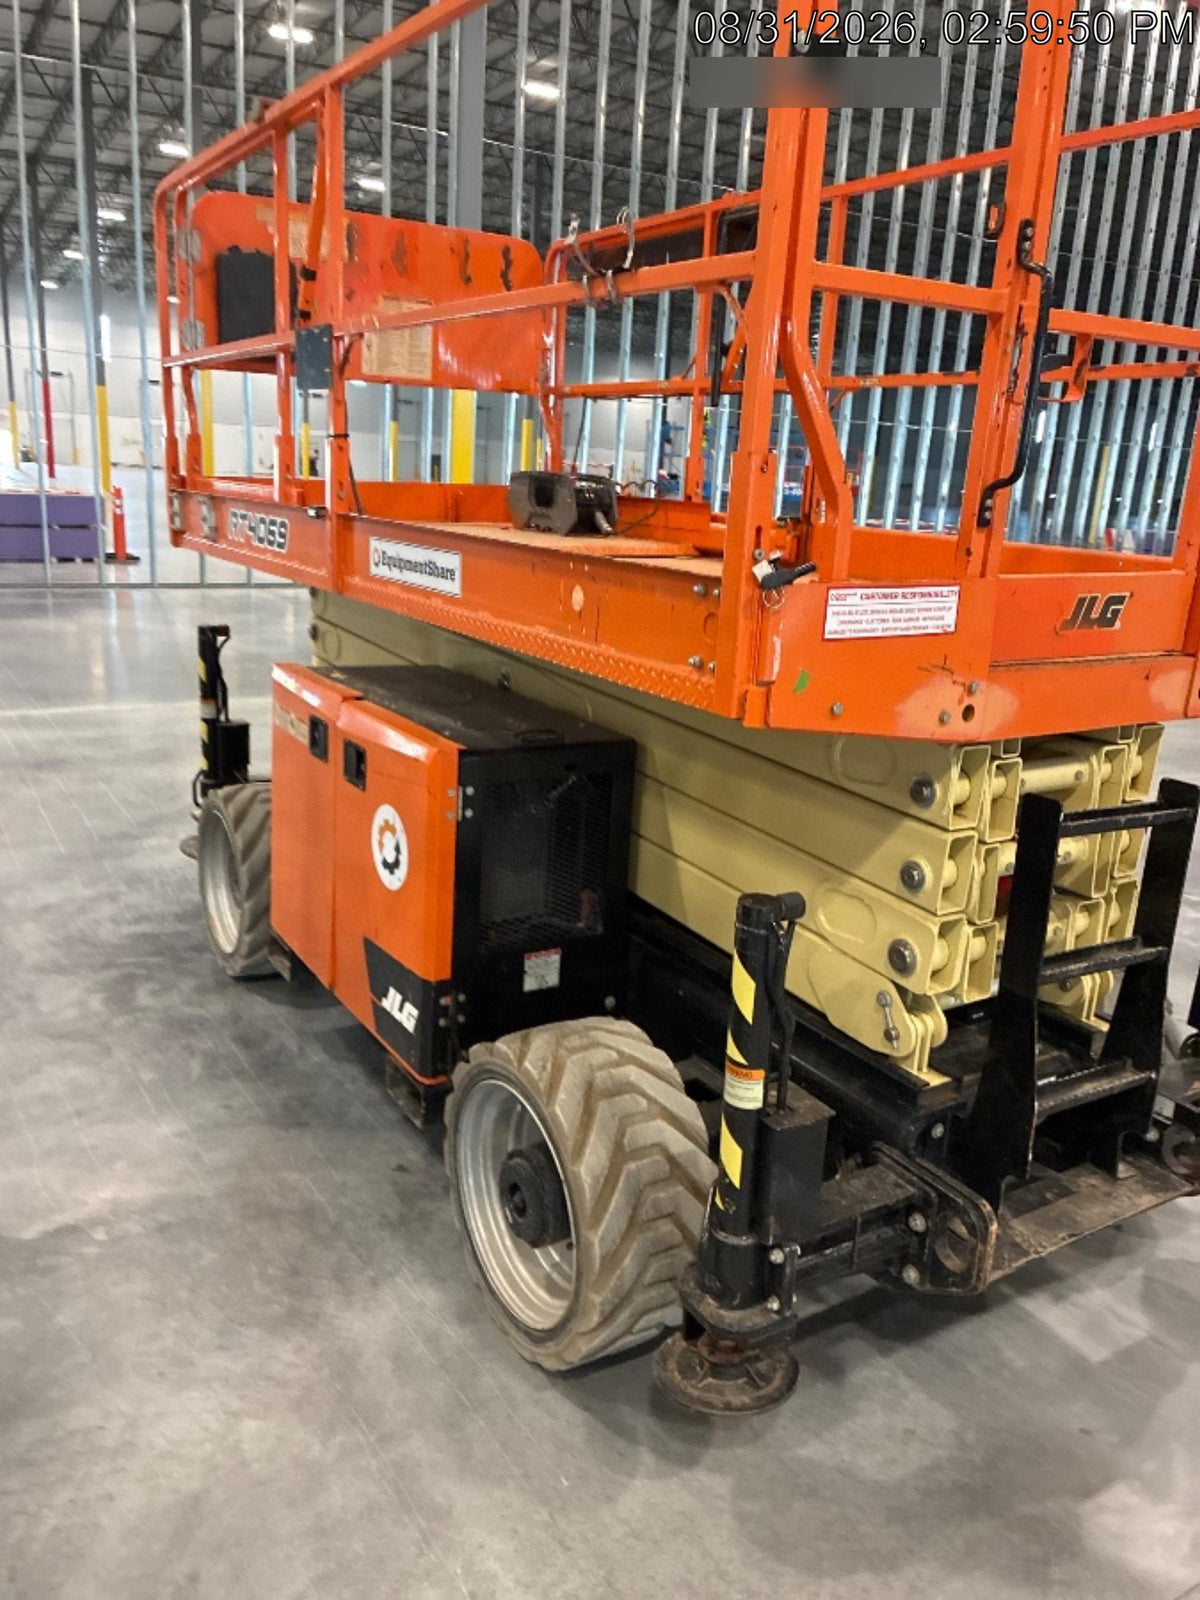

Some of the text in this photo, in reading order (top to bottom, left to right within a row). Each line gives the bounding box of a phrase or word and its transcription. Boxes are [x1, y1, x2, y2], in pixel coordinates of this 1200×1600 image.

[381, 551, 456, 581] EquipmentShare
[1058, 592, 1130, 632] JLG
[381, 986, 419, 1034] JLG
